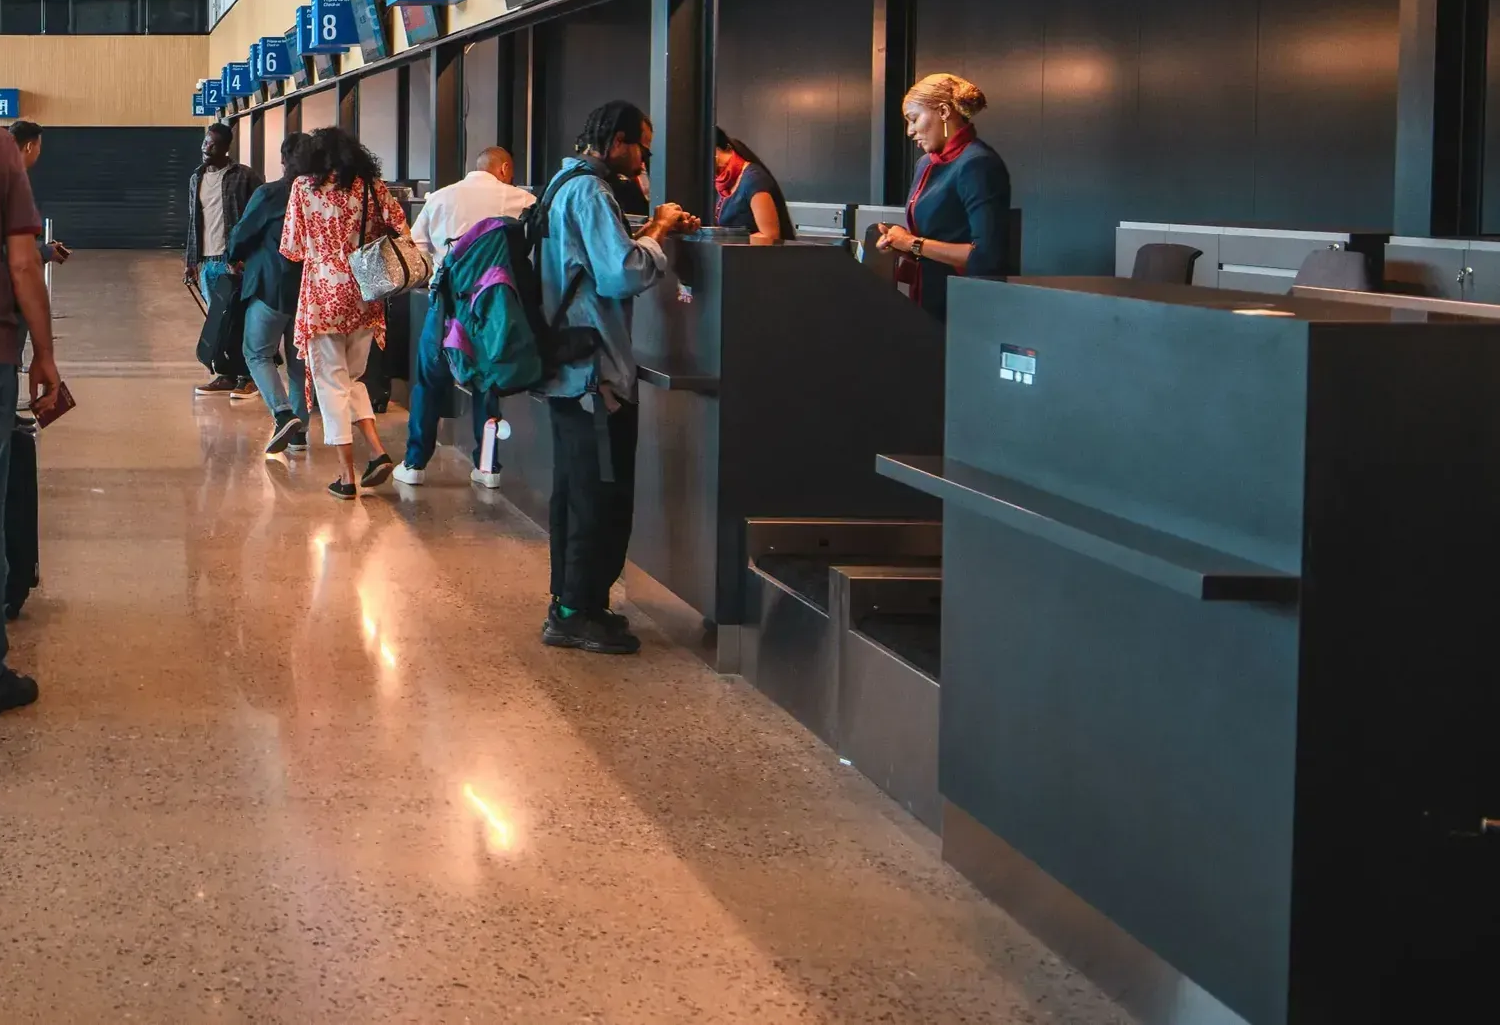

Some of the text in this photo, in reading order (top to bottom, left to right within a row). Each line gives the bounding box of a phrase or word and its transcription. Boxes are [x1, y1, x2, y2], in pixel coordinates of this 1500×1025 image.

[323, 14, 337, 40] 8
[266, 52, 277, 72] 6
[231, 74, 241, 91] 4
[209, 89, 217, 103] 2
